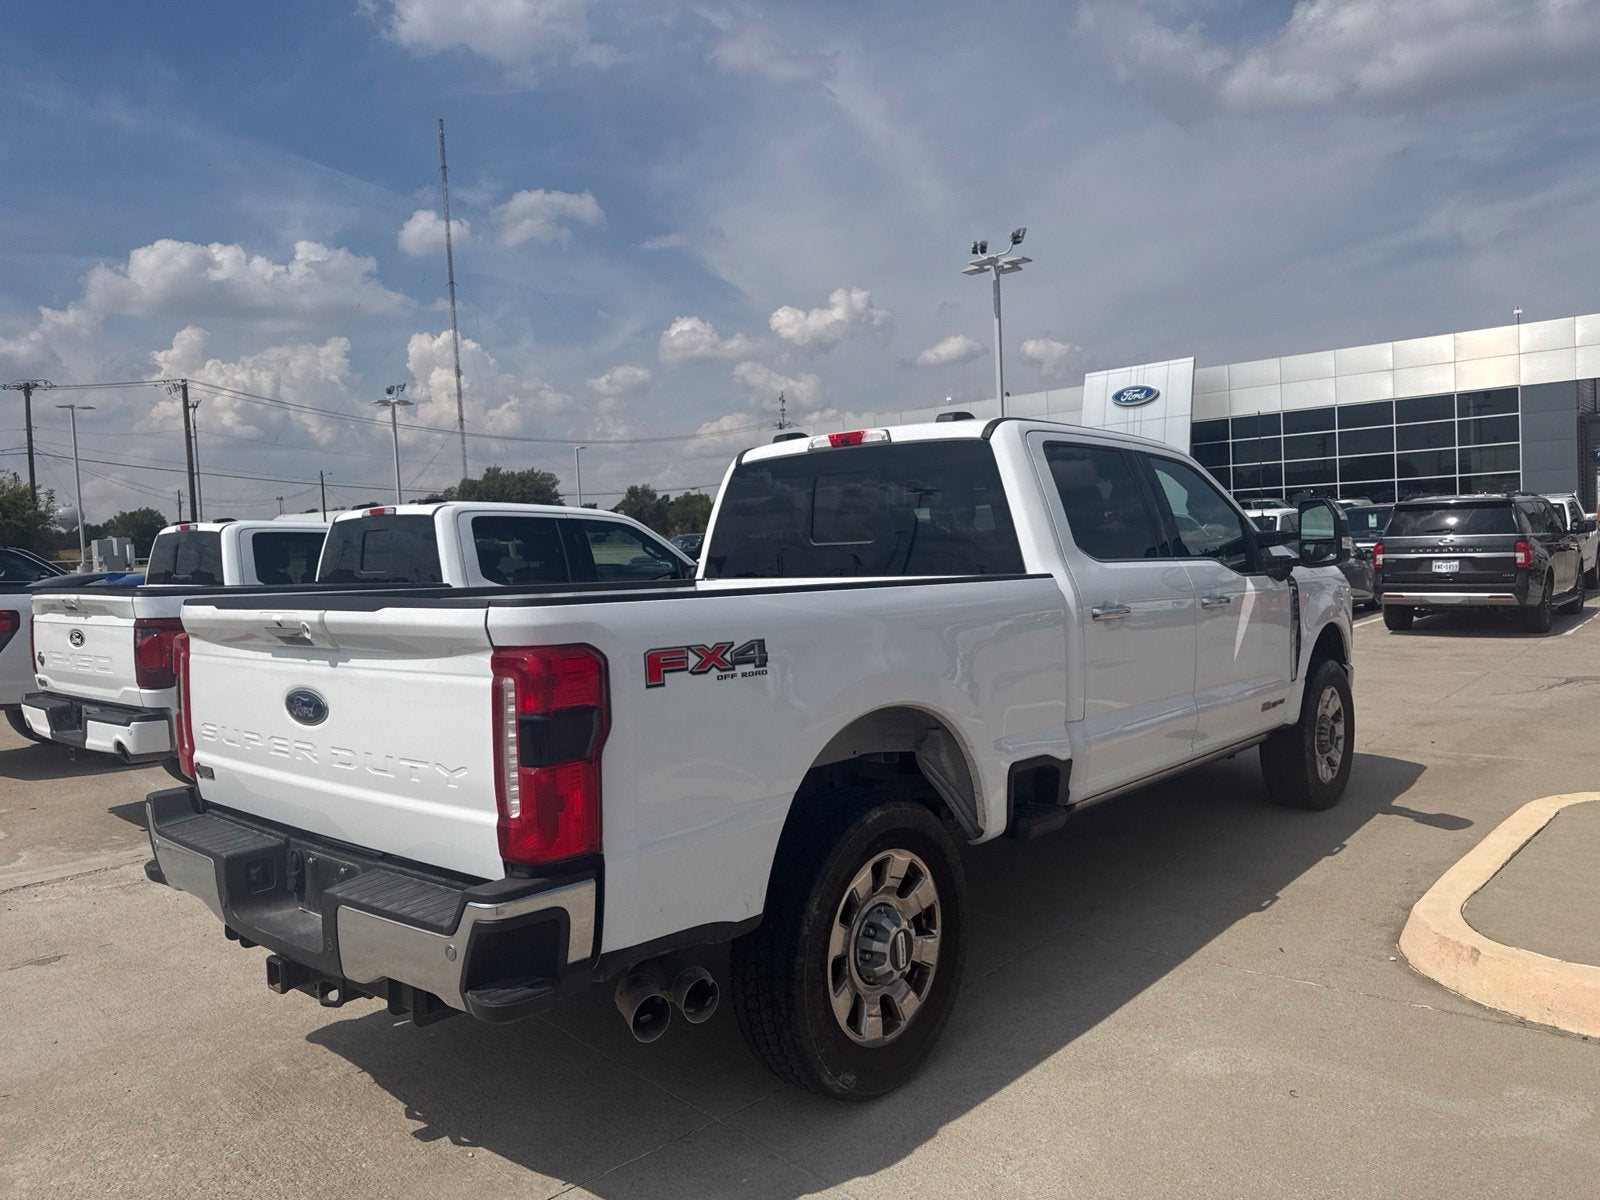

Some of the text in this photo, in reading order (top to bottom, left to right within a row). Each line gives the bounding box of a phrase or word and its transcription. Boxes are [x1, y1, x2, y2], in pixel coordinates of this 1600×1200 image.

[1120, 388, 1147, 402] Ford
[644, 638, 768, 690] FX4
[716, 669, 768, 681] OFF ROAD
[290, 694, 315, 718] Ford
[201, 722, 468, 788] SUPER DUTY
